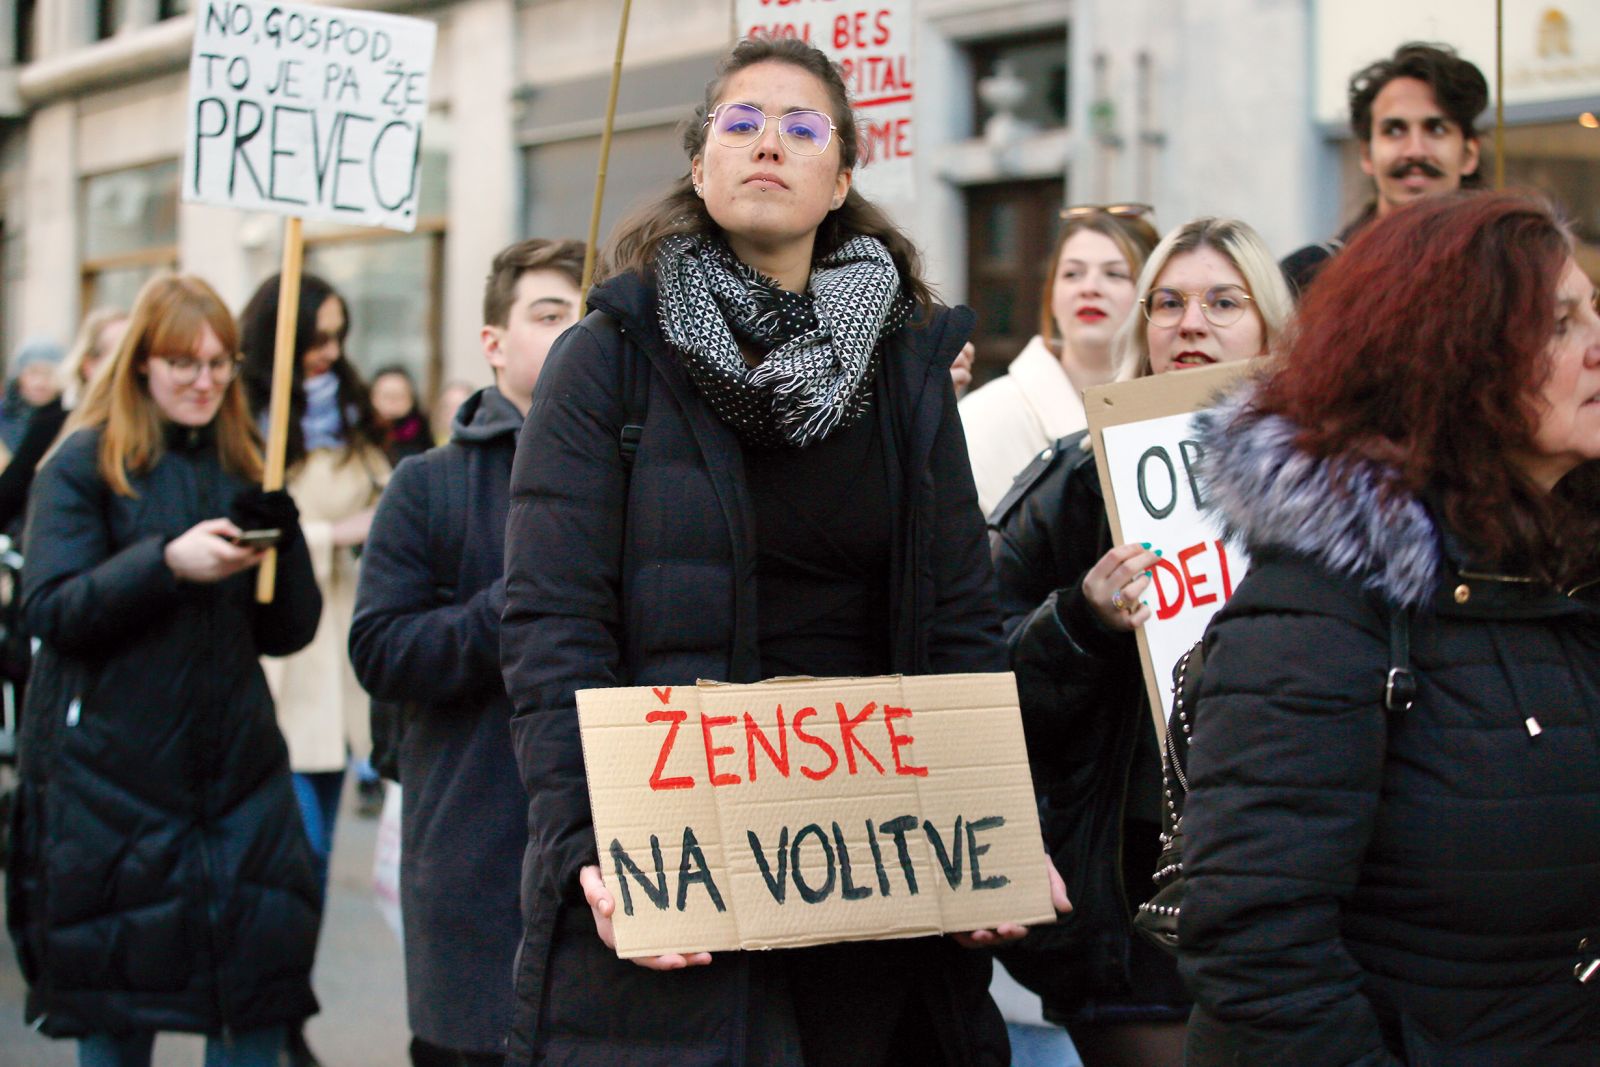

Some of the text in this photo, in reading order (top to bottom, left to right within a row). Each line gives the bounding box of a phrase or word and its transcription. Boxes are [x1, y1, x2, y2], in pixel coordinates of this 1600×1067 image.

[833, 10, 891, 50] BES
[199, 53, 426, 105] TO JE PA ŽE
[646, 687, 929, 791] ŽENSKE
[608, 814, 1011, 917] NA VOLITVE
